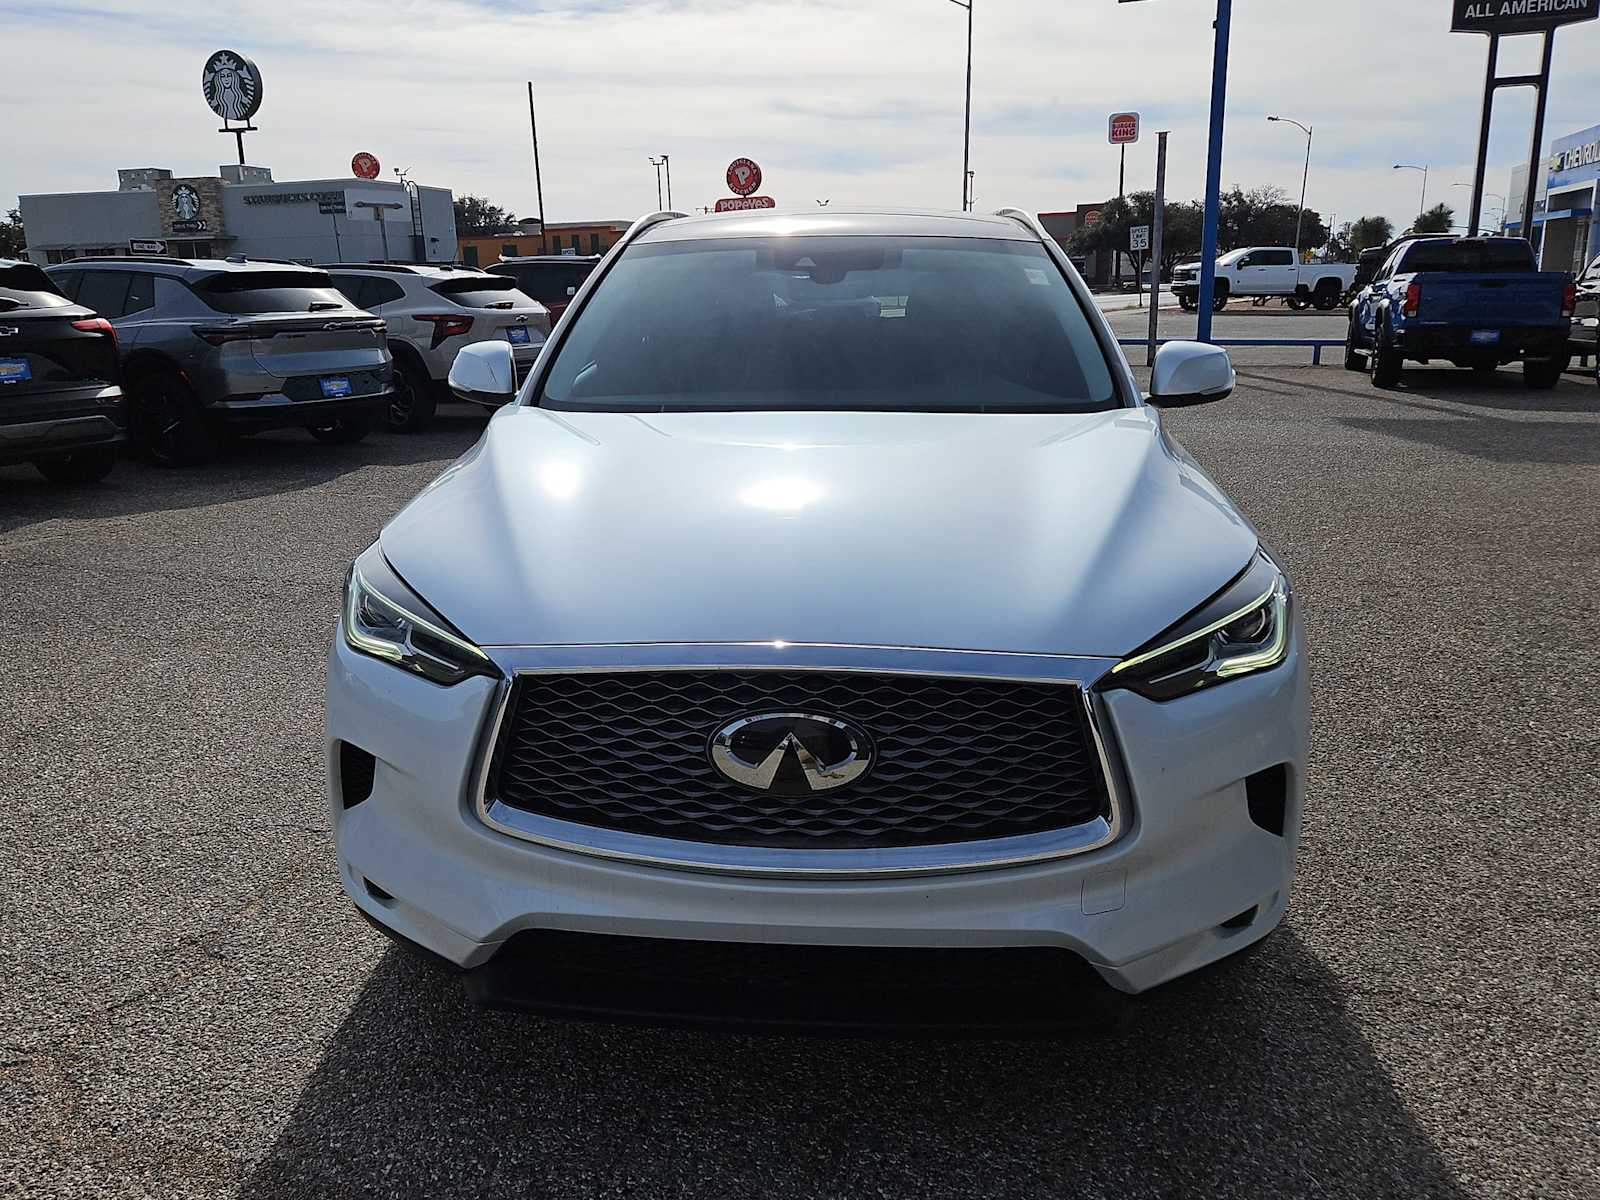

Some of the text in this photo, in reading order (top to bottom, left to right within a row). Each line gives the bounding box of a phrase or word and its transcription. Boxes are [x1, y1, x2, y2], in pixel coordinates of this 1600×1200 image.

[1465, 0, 1587, 18] ALL AMERICAN
[1112, 128, 1136, 137] KING
[1132, 239, 1147, 248] 35
